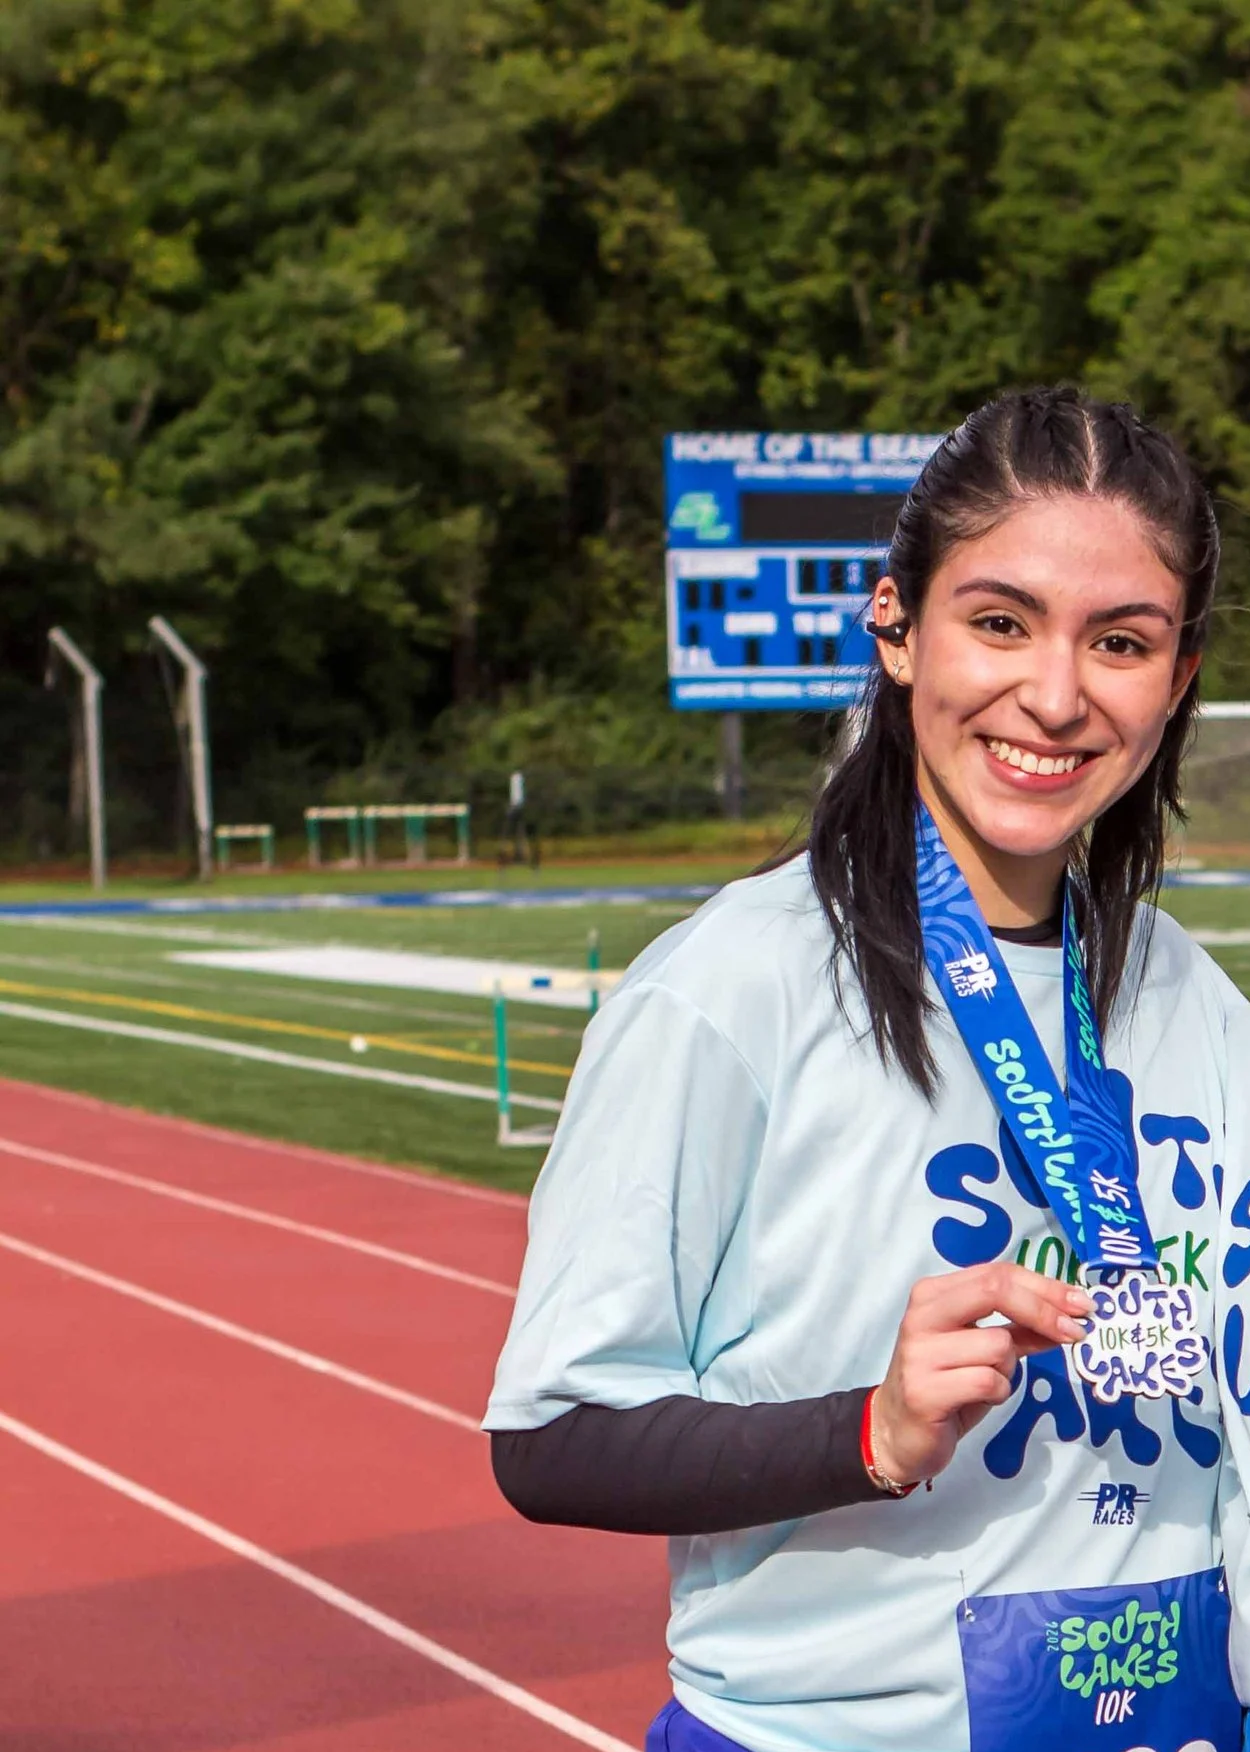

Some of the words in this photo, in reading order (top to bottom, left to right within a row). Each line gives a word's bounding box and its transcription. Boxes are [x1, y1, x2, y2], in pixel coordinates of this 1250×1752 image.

[671, 433, 757, 461] HOME
[763, 433, 803, 461] OF
[811, 433, 861, 461] THE
[944, 961, 975, 998] RACES
[984, 1038, 1073, 1149] SOUTH
[1080, 1338, 1202, 1397] LAKES
[1095, 1483, 1137, 1511] PR
[1092, 1508, 1136, 1526] RACES
[1045, 1621, 1060, 1652] 2026
[1060, 1600, 1181, 1653] SOUTH
[1060, 1643, 1179, 1699] LAKES
[1095, 1689, 1137, 1727] 10K
